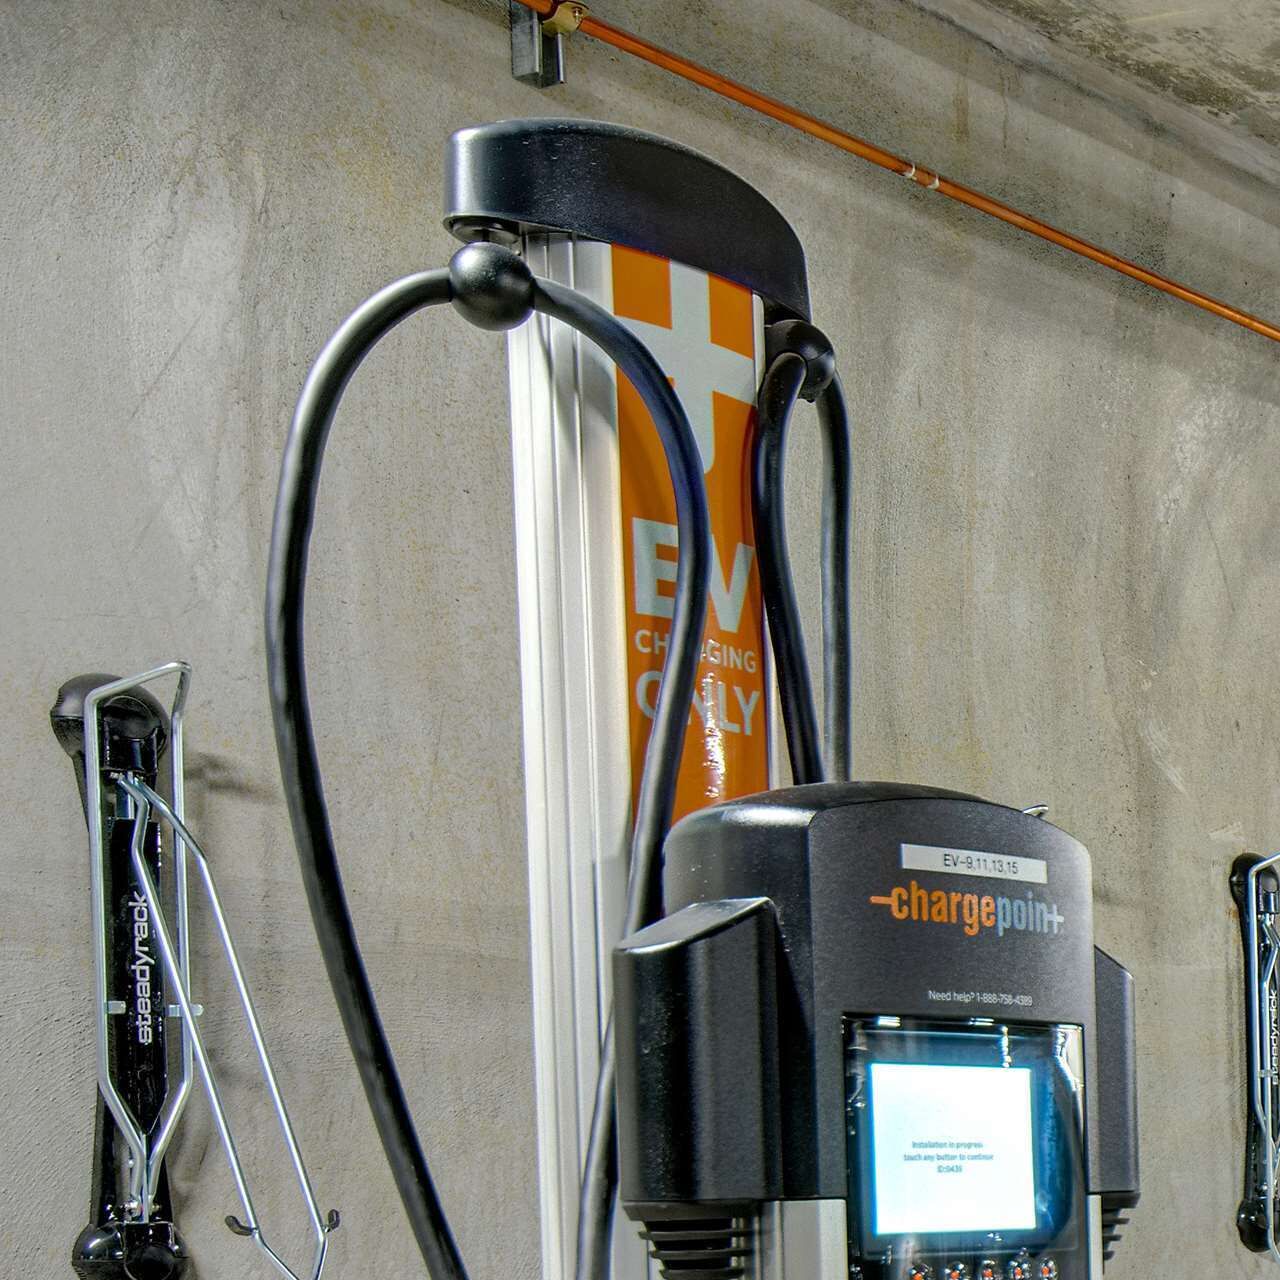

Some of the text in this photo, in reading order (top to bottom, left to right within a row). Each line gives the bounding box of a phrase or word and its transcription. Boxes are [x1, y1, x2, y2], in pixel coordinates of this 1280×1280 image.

[632, 516, 756, 634] EV
[634, 629, 757, 673] CHGING
[943, 853, 1019, 875] EV-9,11,13,15
[132, 891, 155, 1047] steadyrack
[928, 990, 951, 1001] Need
